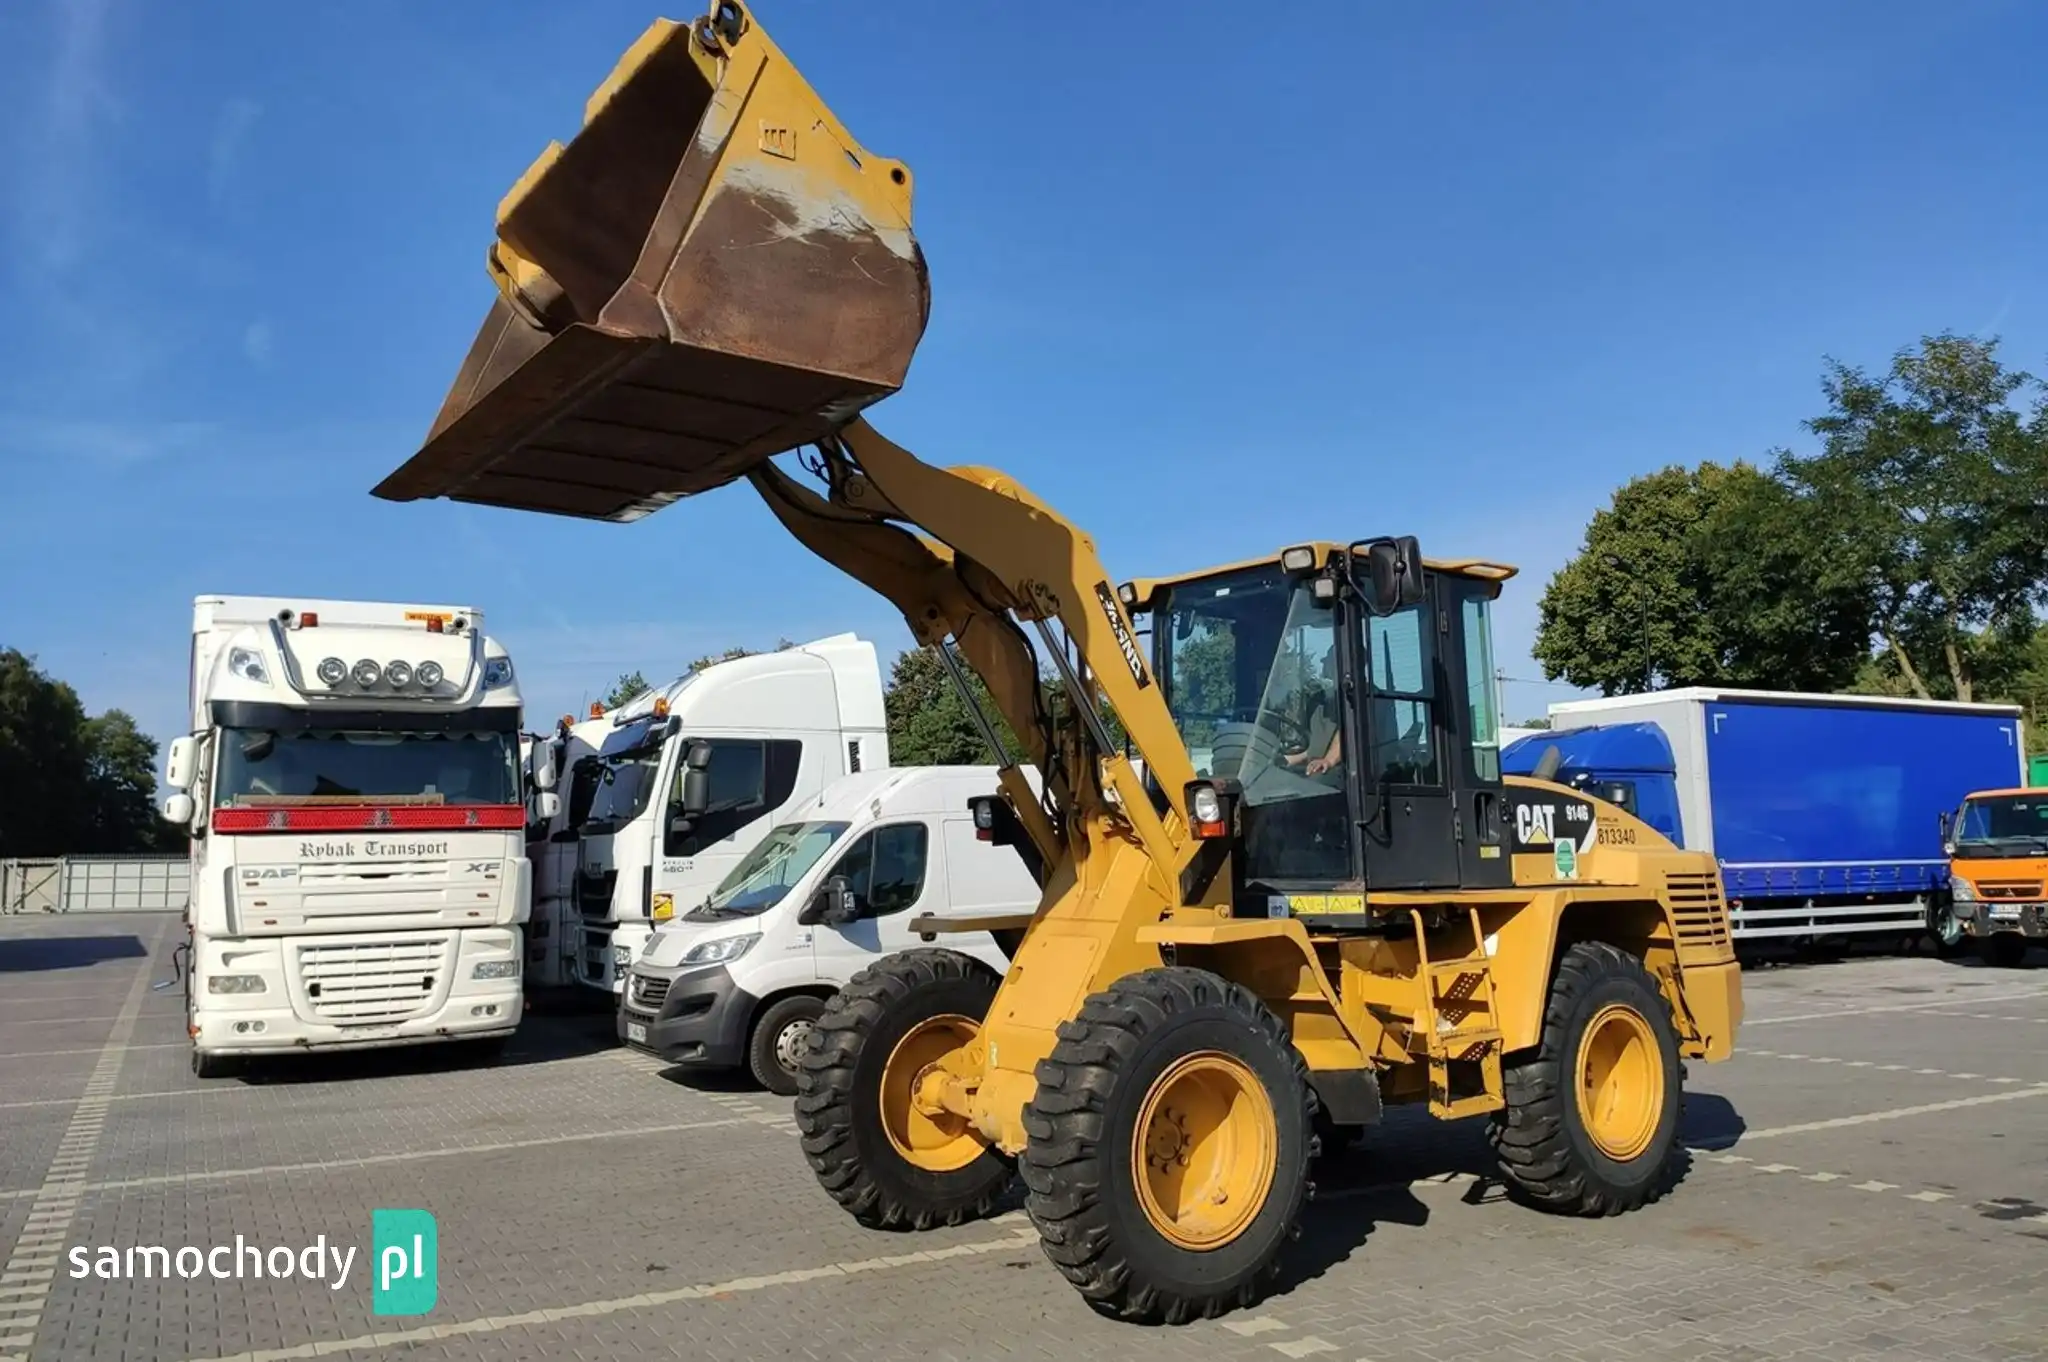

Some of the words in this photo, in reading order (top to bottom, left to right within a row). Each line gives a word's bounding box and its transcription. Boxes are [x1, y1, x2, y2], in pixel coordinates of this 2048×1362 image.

[1516, 804, 1556, 844] CAT
[299, 842, 355, 859] Rybak
[364, 840, 448, 857] Transport
[241, 867, 298, 880] DAF
[464, 862, 500, 873] XF
